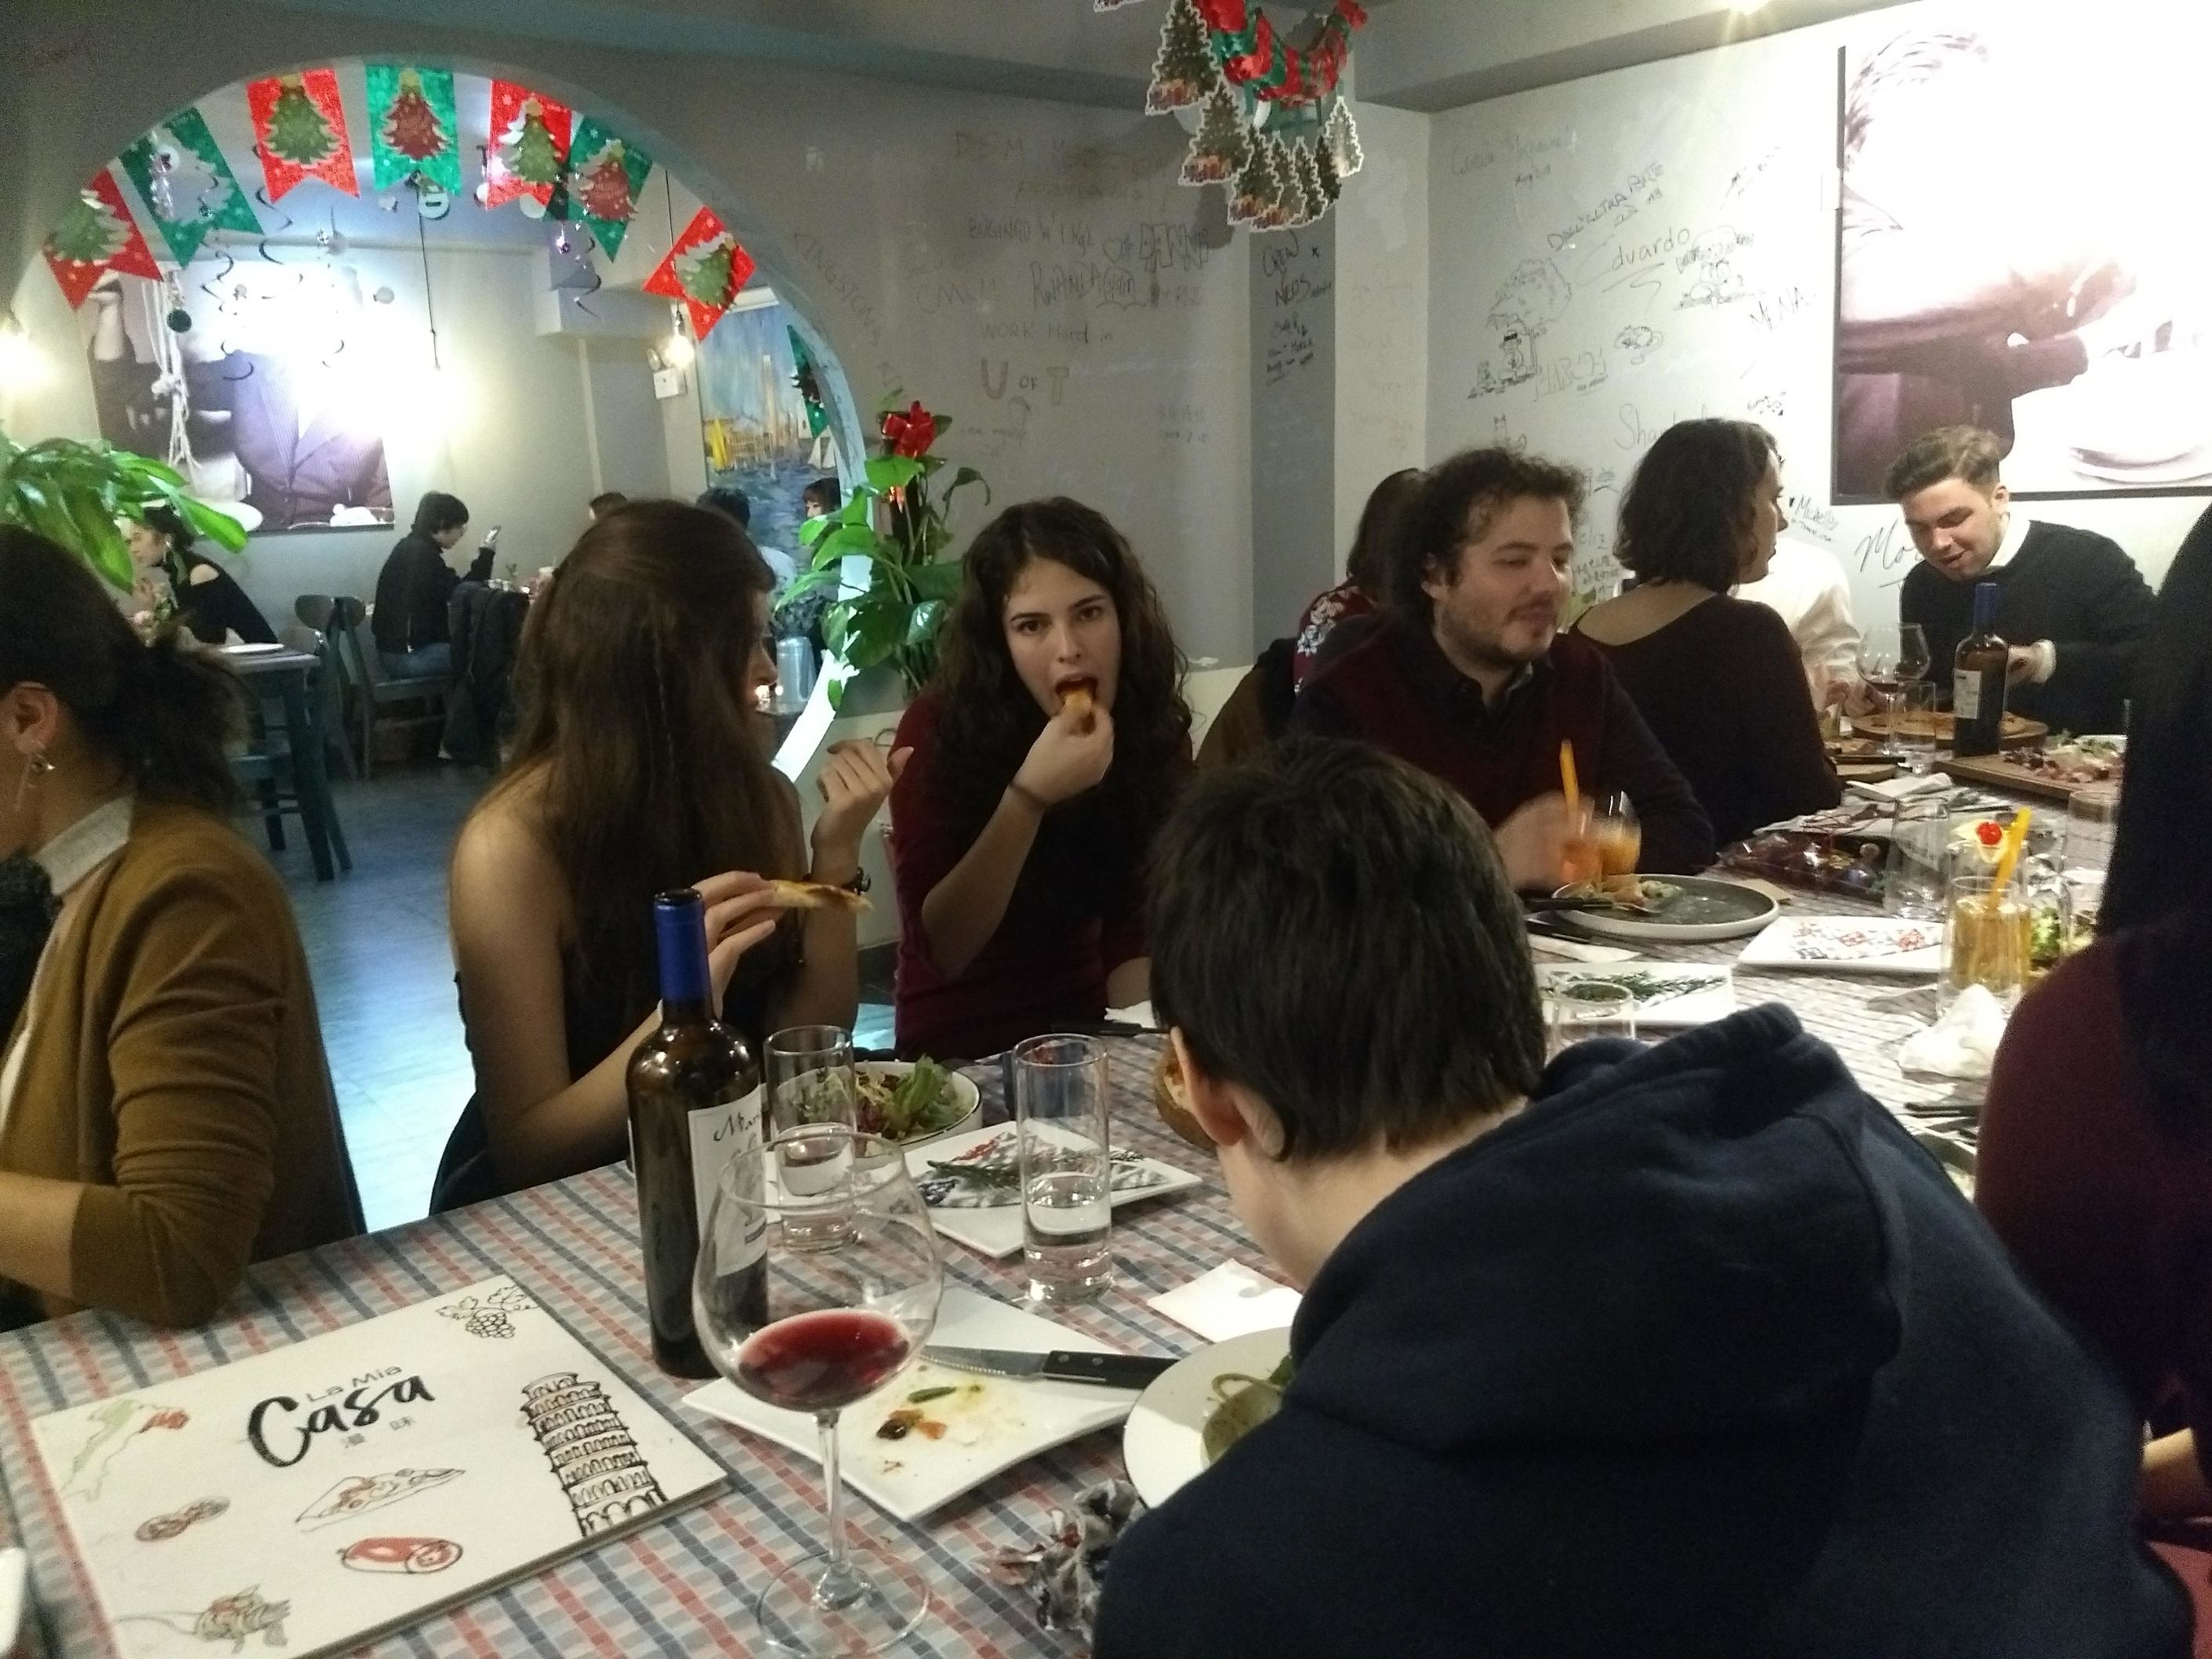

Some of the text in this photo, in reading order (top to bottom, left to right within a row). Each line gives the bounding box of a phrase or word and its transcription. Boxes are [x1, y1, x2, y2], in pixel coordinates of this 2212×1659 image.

[981, 357, 1009, 400] U
[1046, 366, 1070, 407] T
[306, 1366, 402, 1402] La Mia
[247, 1375, 435, 1468] Casa
